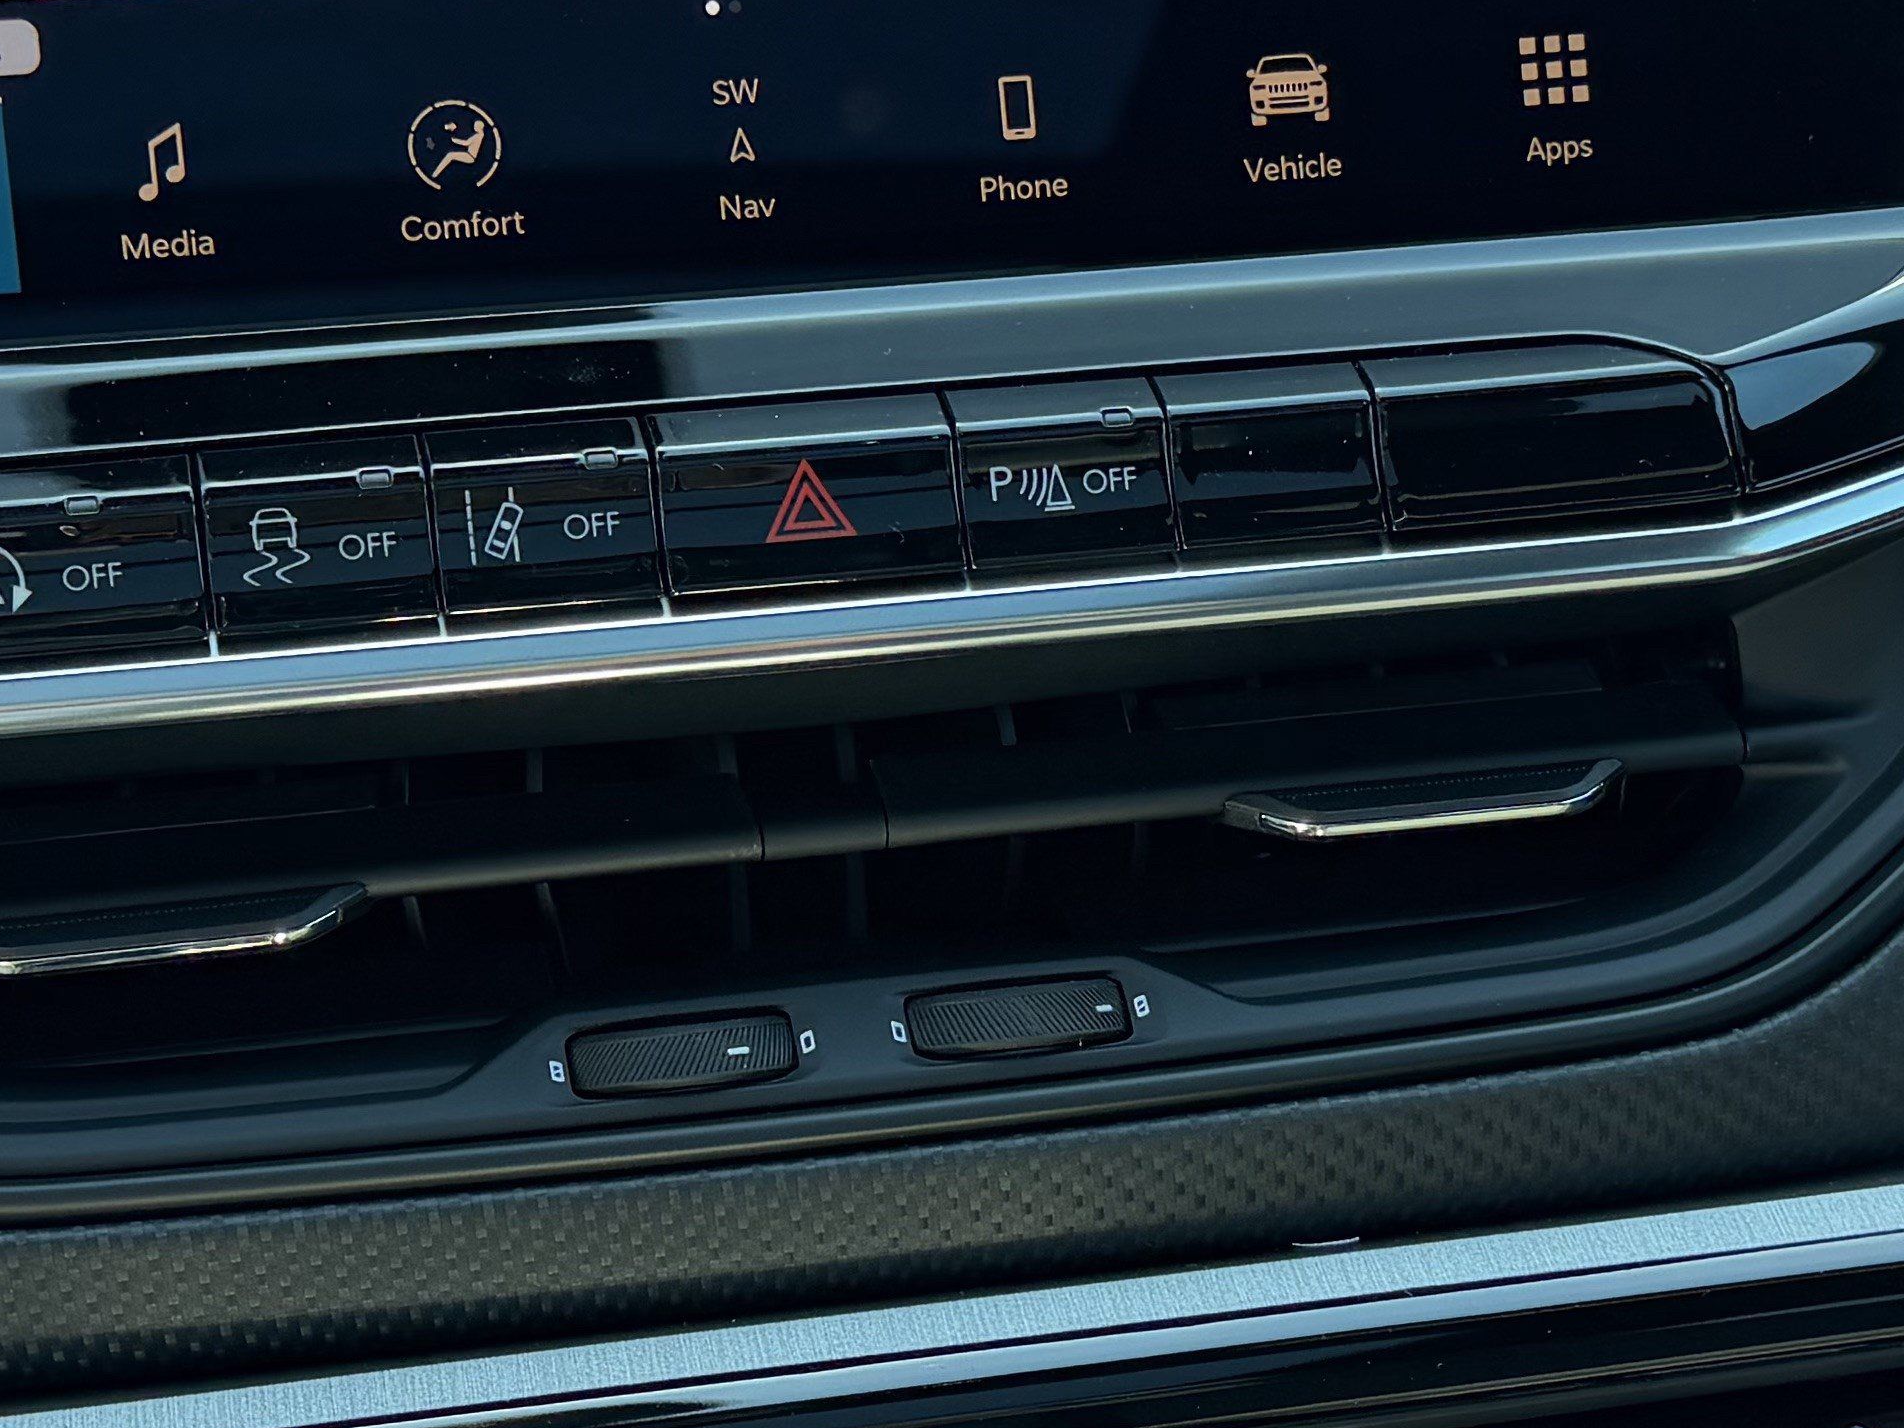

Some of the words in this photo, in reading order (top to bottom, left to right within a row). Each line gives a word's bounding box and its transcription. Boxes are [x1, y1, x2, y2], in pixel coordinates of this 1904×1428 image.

[713, 78, 759, 104] SW
[1527, 135, 1592, 165] Apps
[1244, 153, 1342, 183] Vehicle
[979, 174, 1068, 202] Phone
[720, 193, 775, 220] Nav
[401, 211, 524, 244] Comfort
[122, 230, 214, 261] Media
[1084, 467, 1137, 495] OFF
[564, 510, 619, 539] OFF
[339, 533, 396, 560] OFF
[64, 564, 122, 591] OFF
